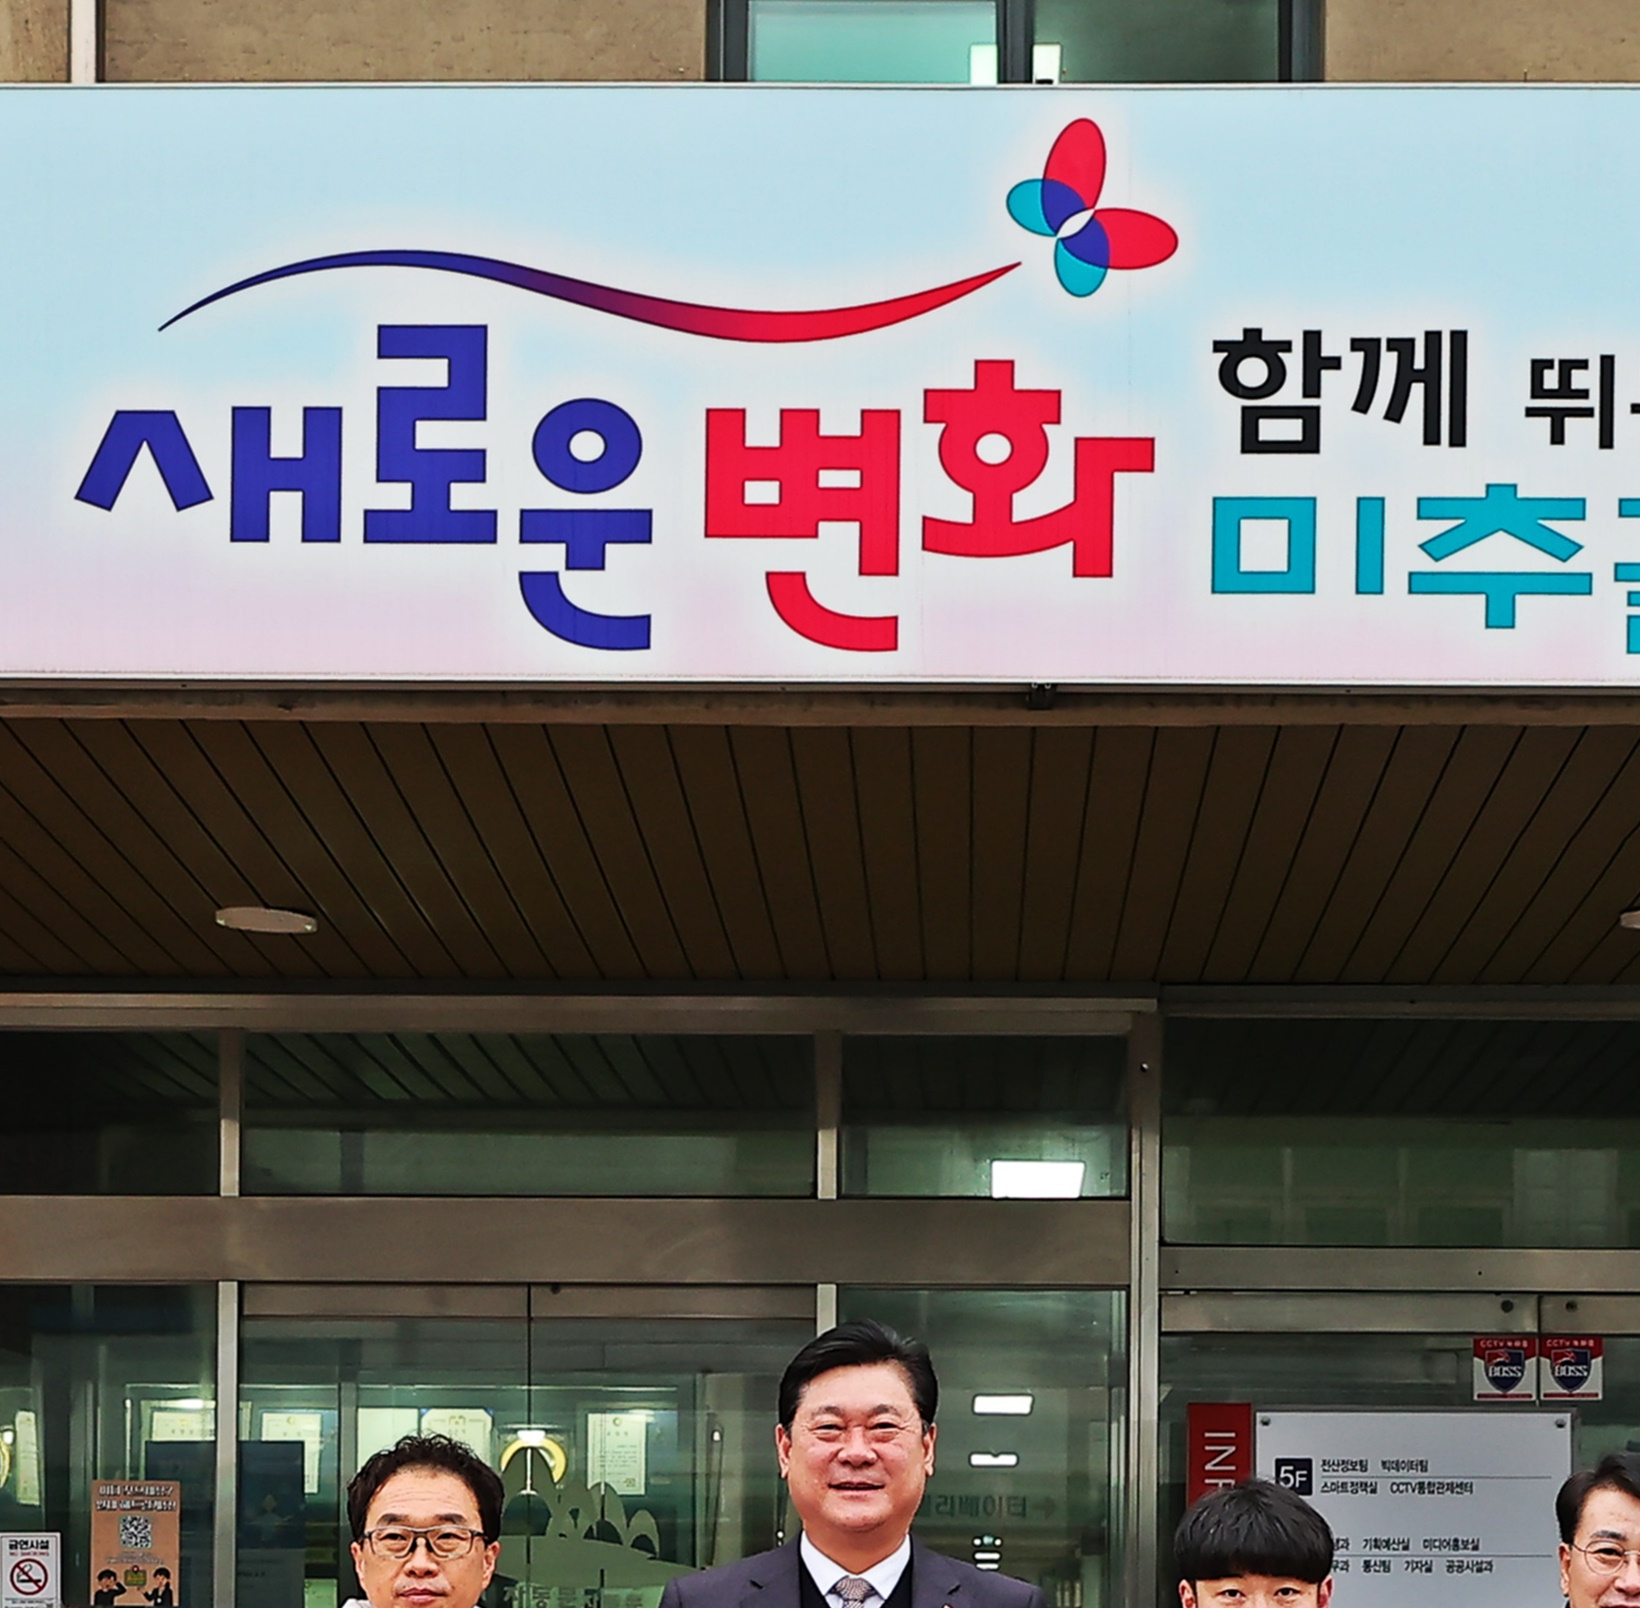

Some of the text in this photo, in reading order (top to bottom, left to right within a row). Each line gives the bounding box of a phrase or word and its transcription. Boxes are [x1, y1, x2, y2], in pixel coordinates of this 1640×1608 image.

[1213, 328, 1467, 454] 함께
[74, 323, 1154, 651] 새로운 변화
[1279, 1465, 1308, 1488] 5F
[920, 1495, 1027, 1518] 리베이터
[8, 1539, 50, 1551] 금연시설
